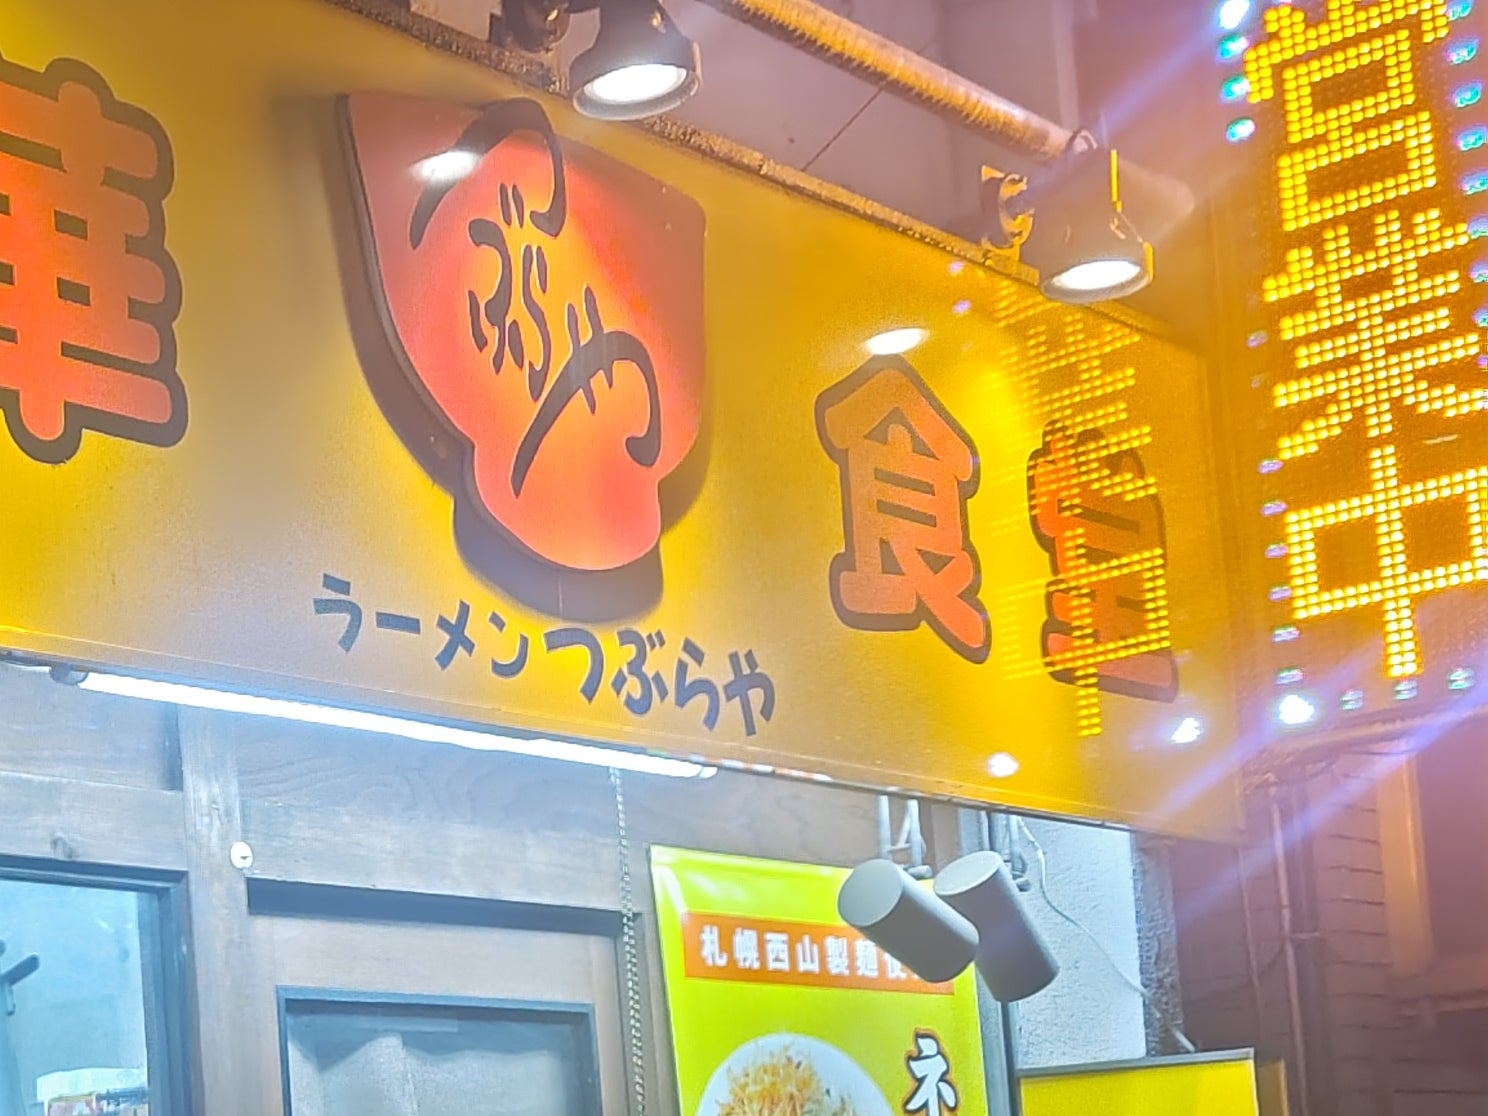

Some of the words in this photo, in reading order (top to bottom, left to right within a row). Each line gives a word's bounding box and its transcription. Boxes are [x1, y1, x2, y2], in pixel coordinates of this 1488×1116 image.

[312, 572, 777, 738] ラーメンつぶらや
[699, 923, 924, 980] 札幌西山製麺使
